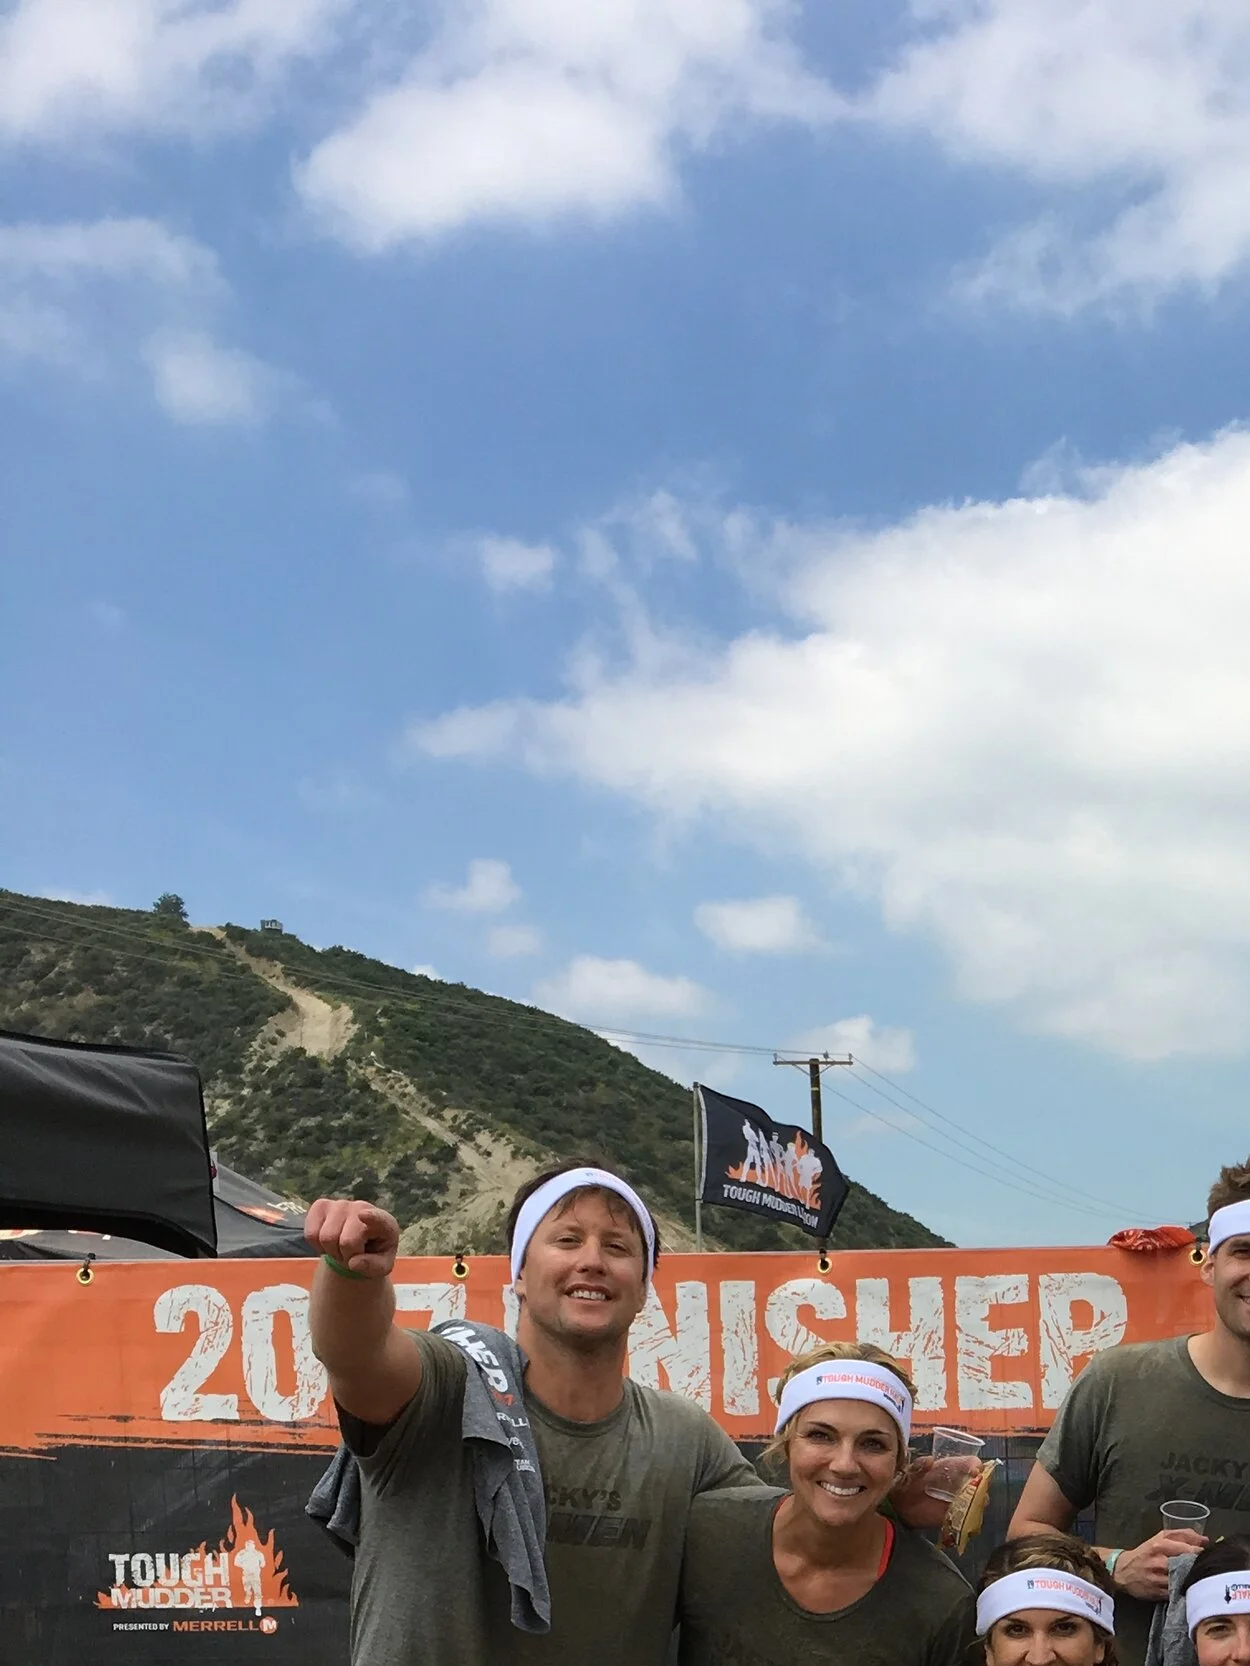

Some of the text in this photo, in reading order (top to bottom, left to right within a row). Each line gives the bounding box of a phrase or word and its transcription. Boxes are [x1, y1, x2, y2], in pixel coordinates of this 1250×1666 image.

[723, 1184, 760, 1205] TOUGH
[153, 1283, 466, 1422] 207
[823, 1373, 854, 1384] TOUGH
[855, 1375, 890, 1393] MUDDER
[109, 1552, 230, 1587] TOUGH
[1034, 1578, 1065, 1590] TOUGH
[110, 1587, 232, 1610] MUDDER
[113, 1623, 157, 1631] PRESENTED
[158, 1623, 169, 1631] BY
[173, 1620, 258, 1632] MERRELL
